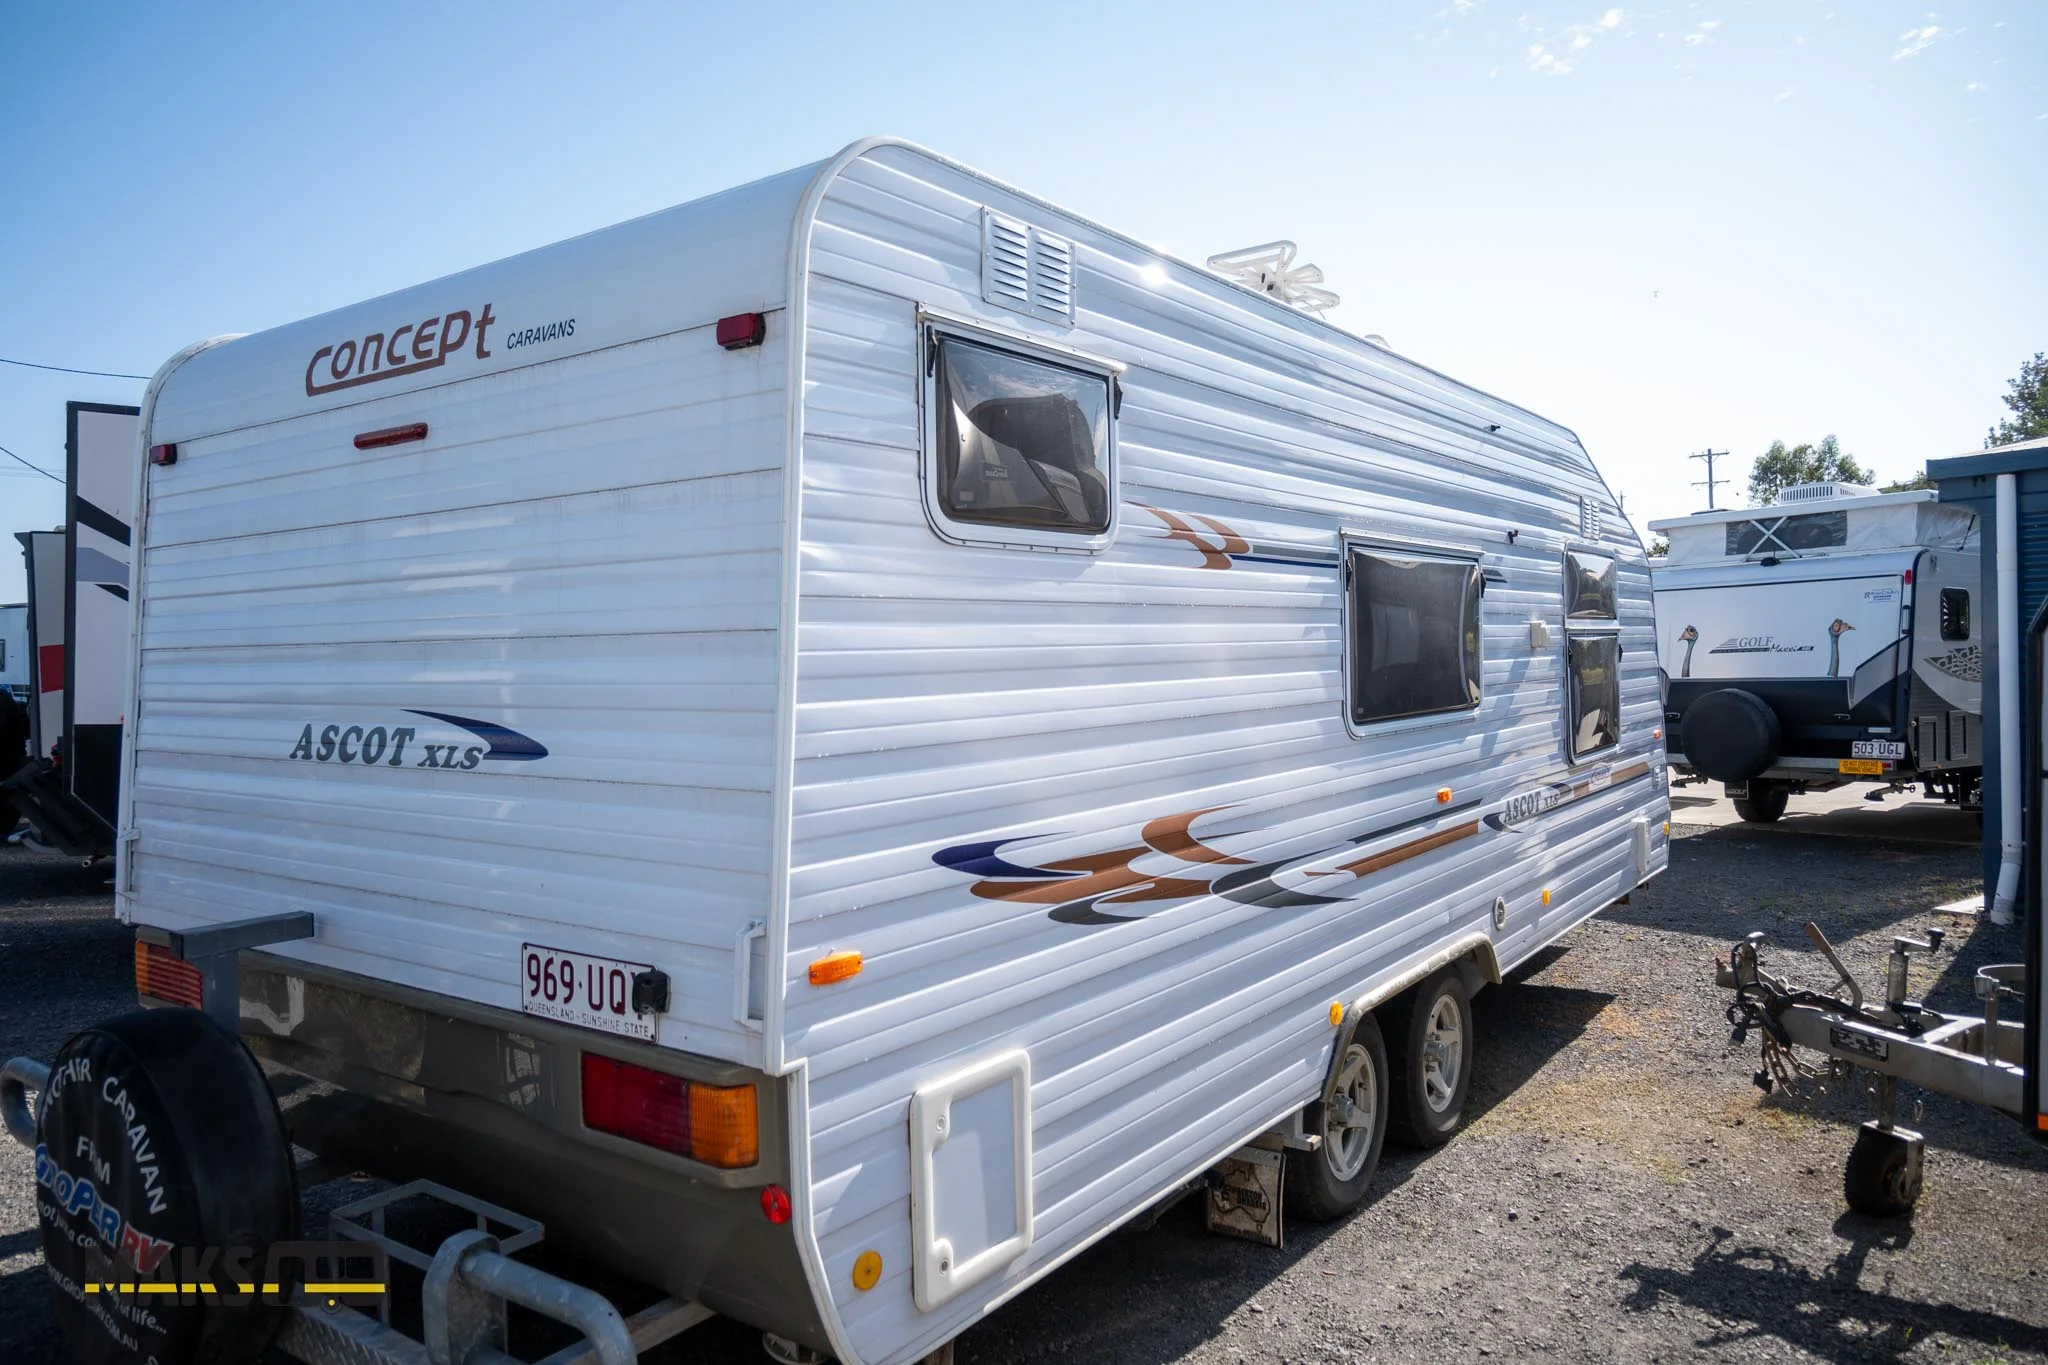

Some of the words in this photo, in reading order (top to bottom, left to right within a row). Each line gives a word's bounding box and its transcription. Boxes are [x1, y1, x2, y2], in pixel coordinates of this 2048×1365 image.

[507, 318, 576, 350] CARAVANS
[1739, 636, 1774, 648] GOLF
[289, 723, 416, 766] ASCOT
[417, 744, 484, 770] XLS
[1503, 791, 1542, 823] ASCOT
[527, 1001, 575, 1021] QUEENSLAND
[581, 1014, 621, 1032] SUNSHINE
[624, 1022, 649, 1038] STATE
[102, 1077, 167, 1215] CARAVAN
[120, 1220, 175, 1274] RV
